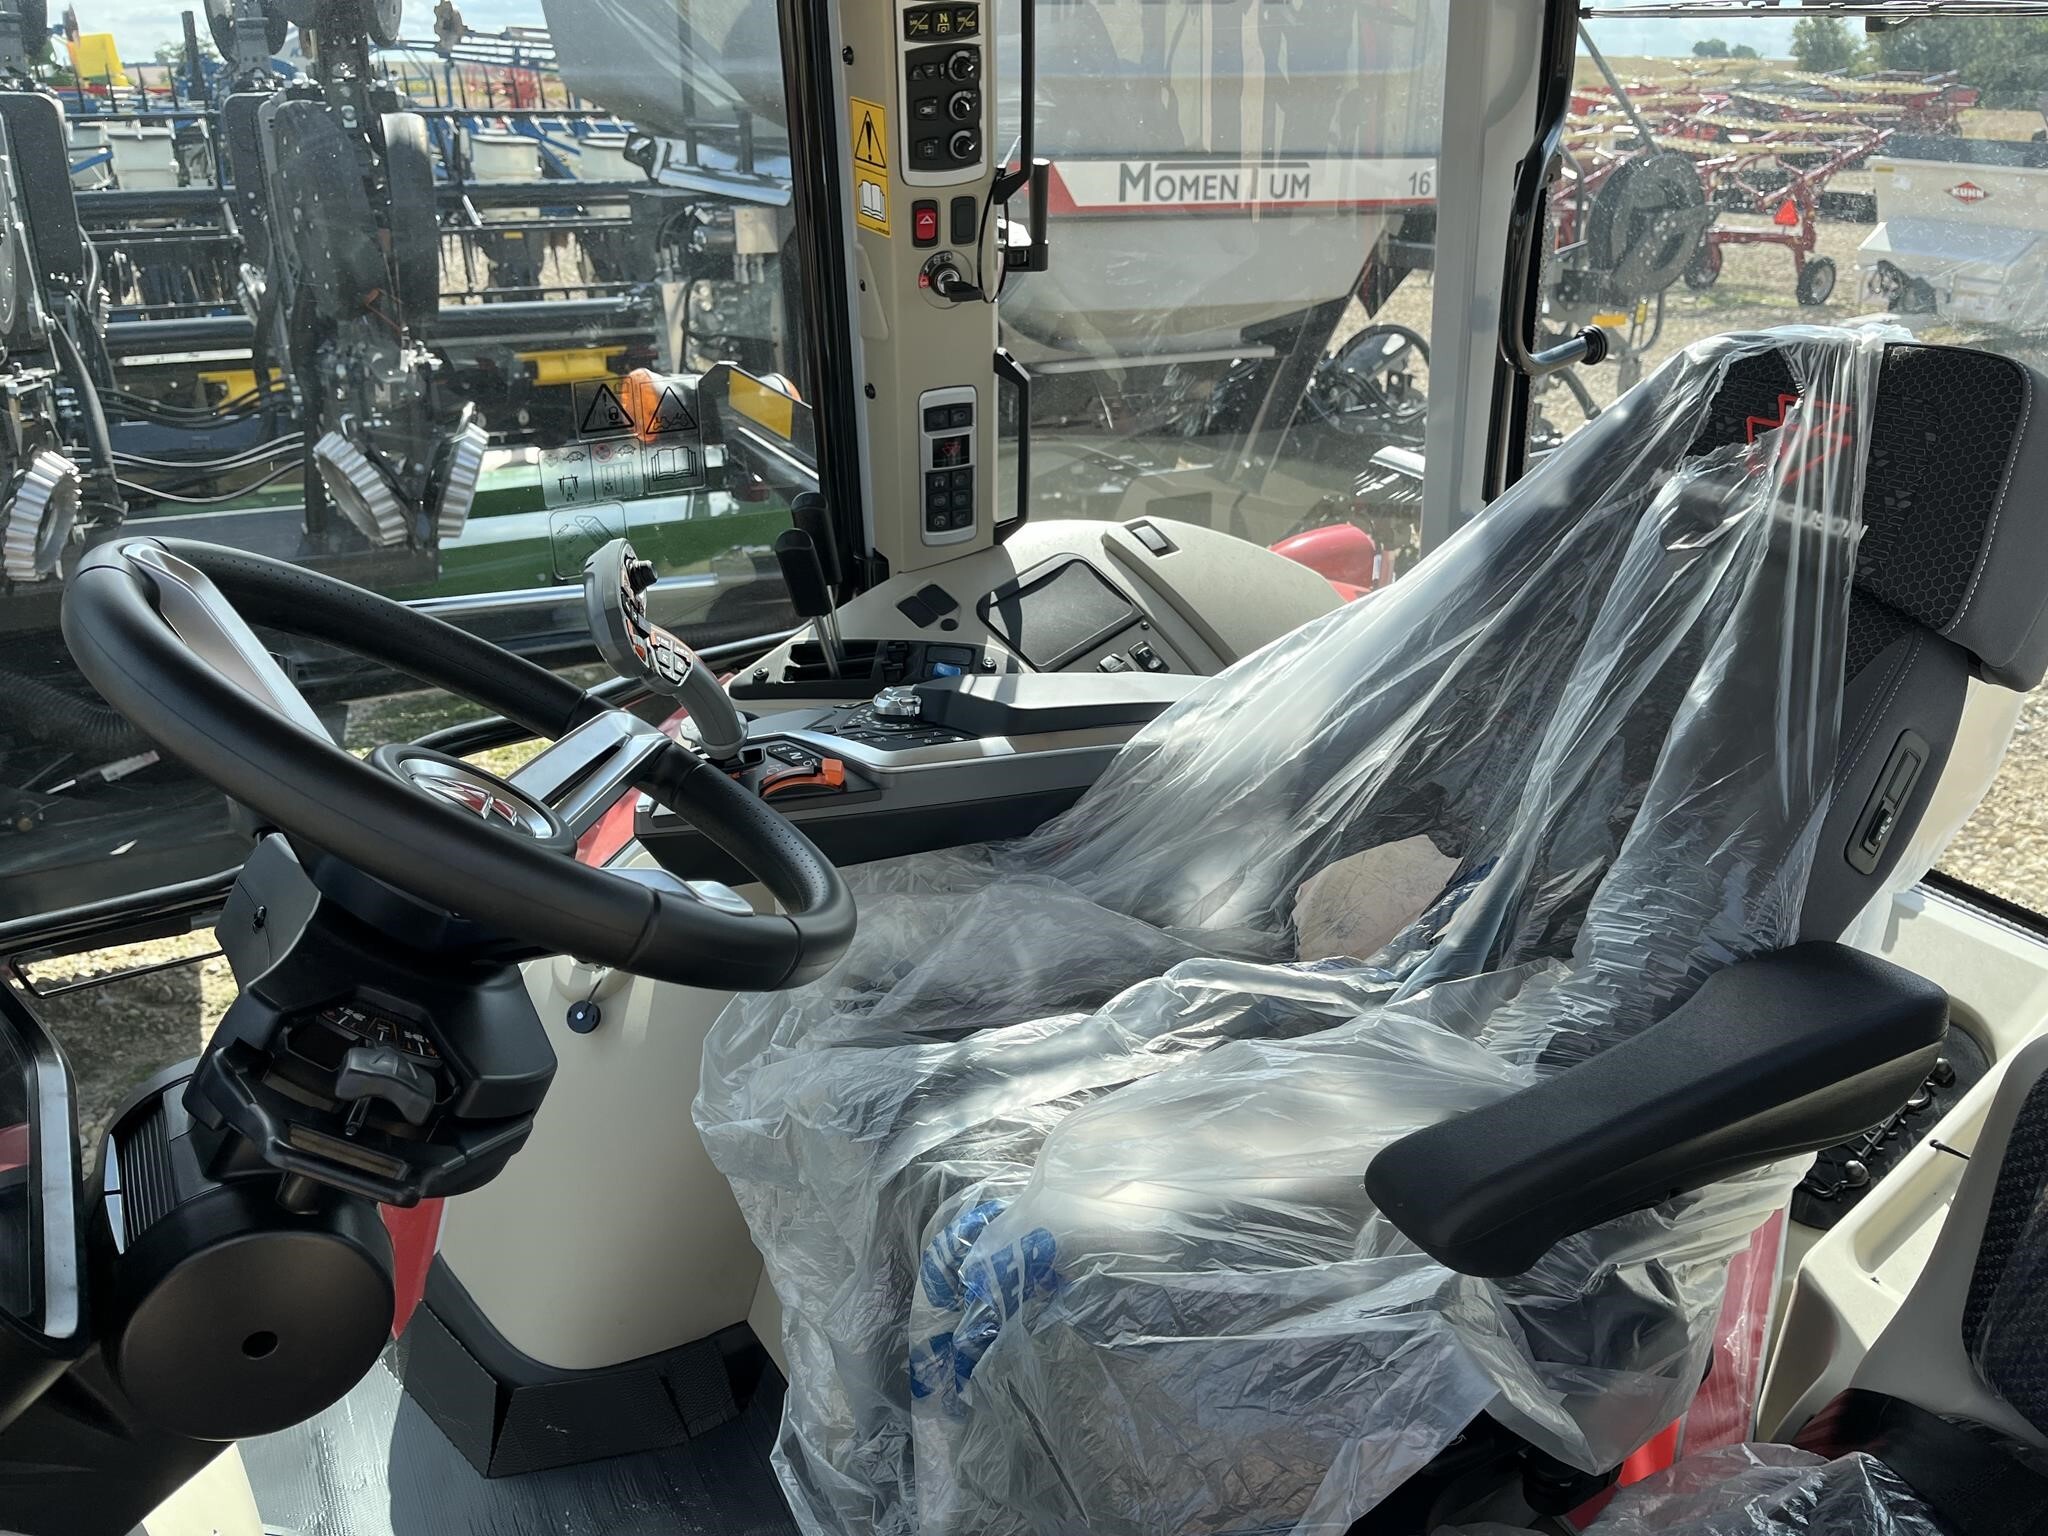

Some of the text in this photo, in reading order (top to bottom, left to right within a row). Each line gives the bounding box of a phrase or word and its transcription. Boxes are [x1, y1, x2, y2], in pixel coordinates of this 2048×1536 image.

[939, 12, 949, 23] N
[1119, 162, 1311, 203] MOMENTUM
[1951, 187, 1985, 199] KUHN
